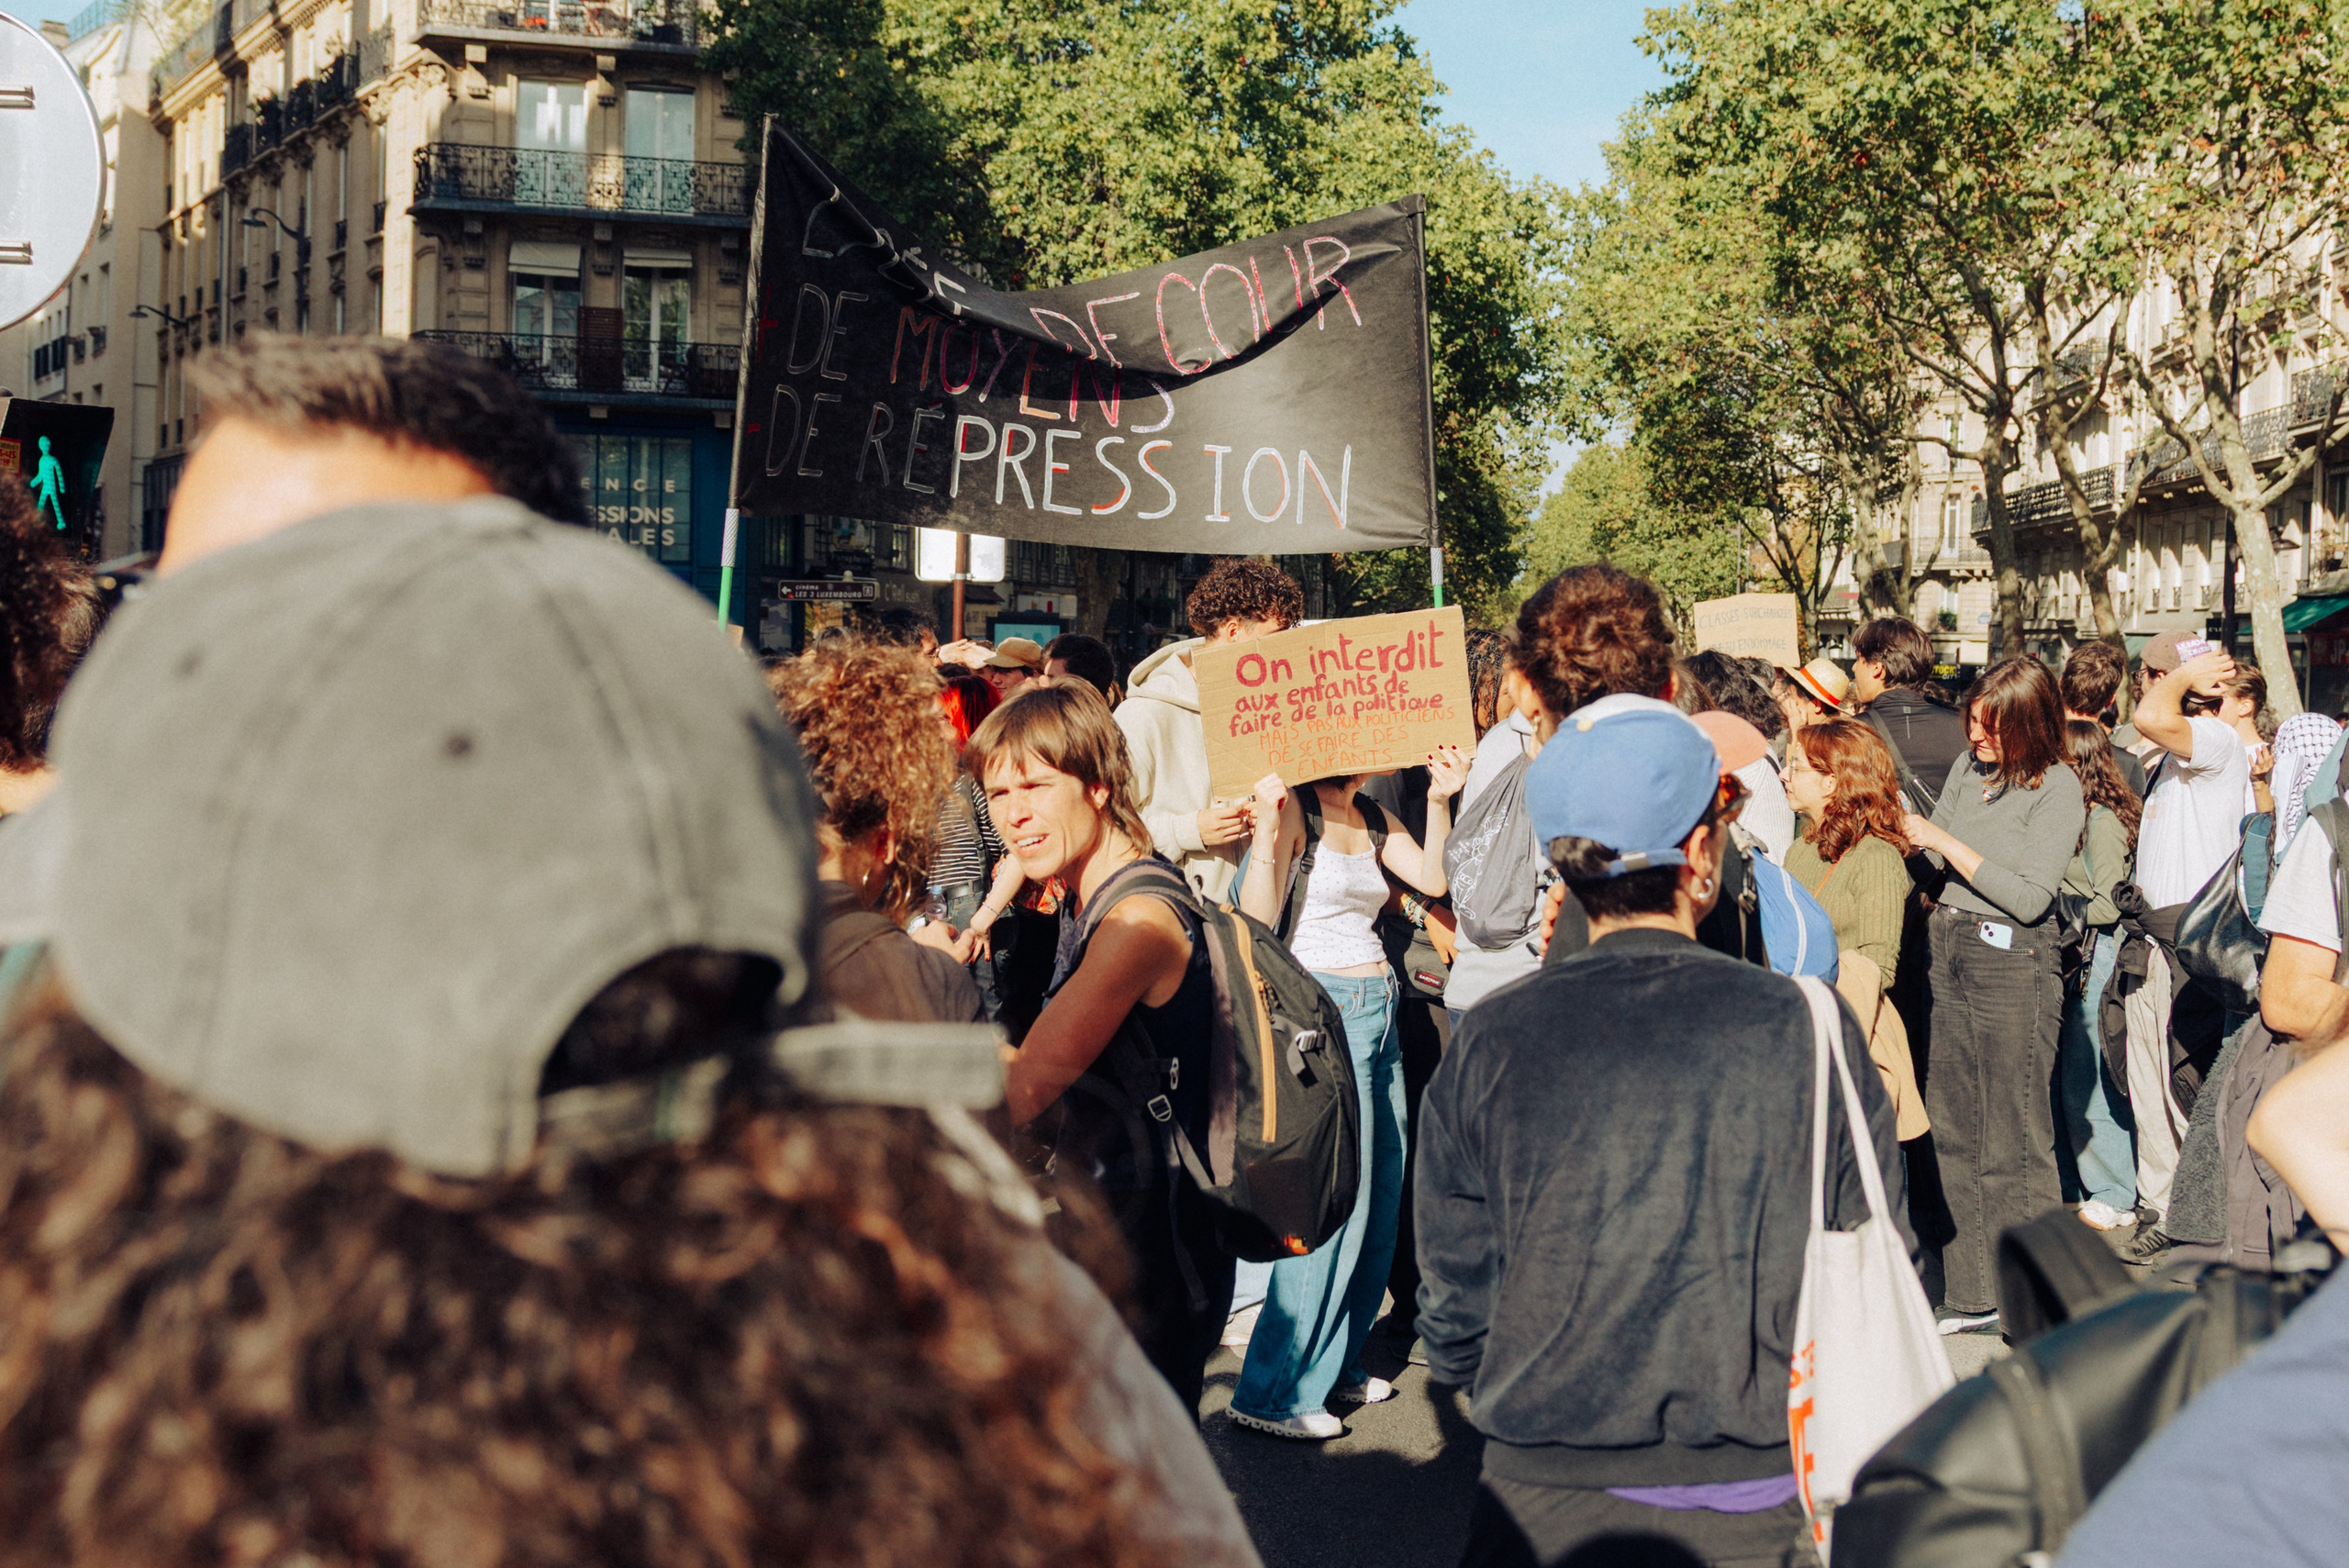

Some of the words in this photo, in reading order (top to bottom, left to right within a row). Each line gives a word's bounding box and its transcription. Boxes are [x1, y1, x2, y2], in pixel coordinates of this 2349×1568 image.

[786, 283, 870, 381] DE
[890, 304, 1176, 434] MOYENS
[765, 384, 842, 477] DE
[857, 397, 1352, 529] RÉPRESSION
[580, 476, 675, 494] ENCE
[590, 504, 675, 525] SSIONS
[606, 526, 675, 546] ALES
[816, 591, 863, 599] LUXEMBOURG
[1698, 608, 1741, 629] CLASSES
[1236, 652, 1293, 687] On
[1308, 619, 1444, 675] interdit
[1235, 692, 1279, 713] aux
[1286, 673, 1377, 706] enfants
[1384, 670, 1409, 695] de
[1229, 711, 1283, 738] faire
[1291, 701, 1318, 723] de
[1326, 701, 1347, 717] la
[1307, 718, 1334, 734] PAS
[1336, 716, 1364, 730] AUX
[1268, 744, 1295, 766] DE
[1373, 725, 1409, 745] DES
[1297, 747, 1394, 780] ENFANTS
